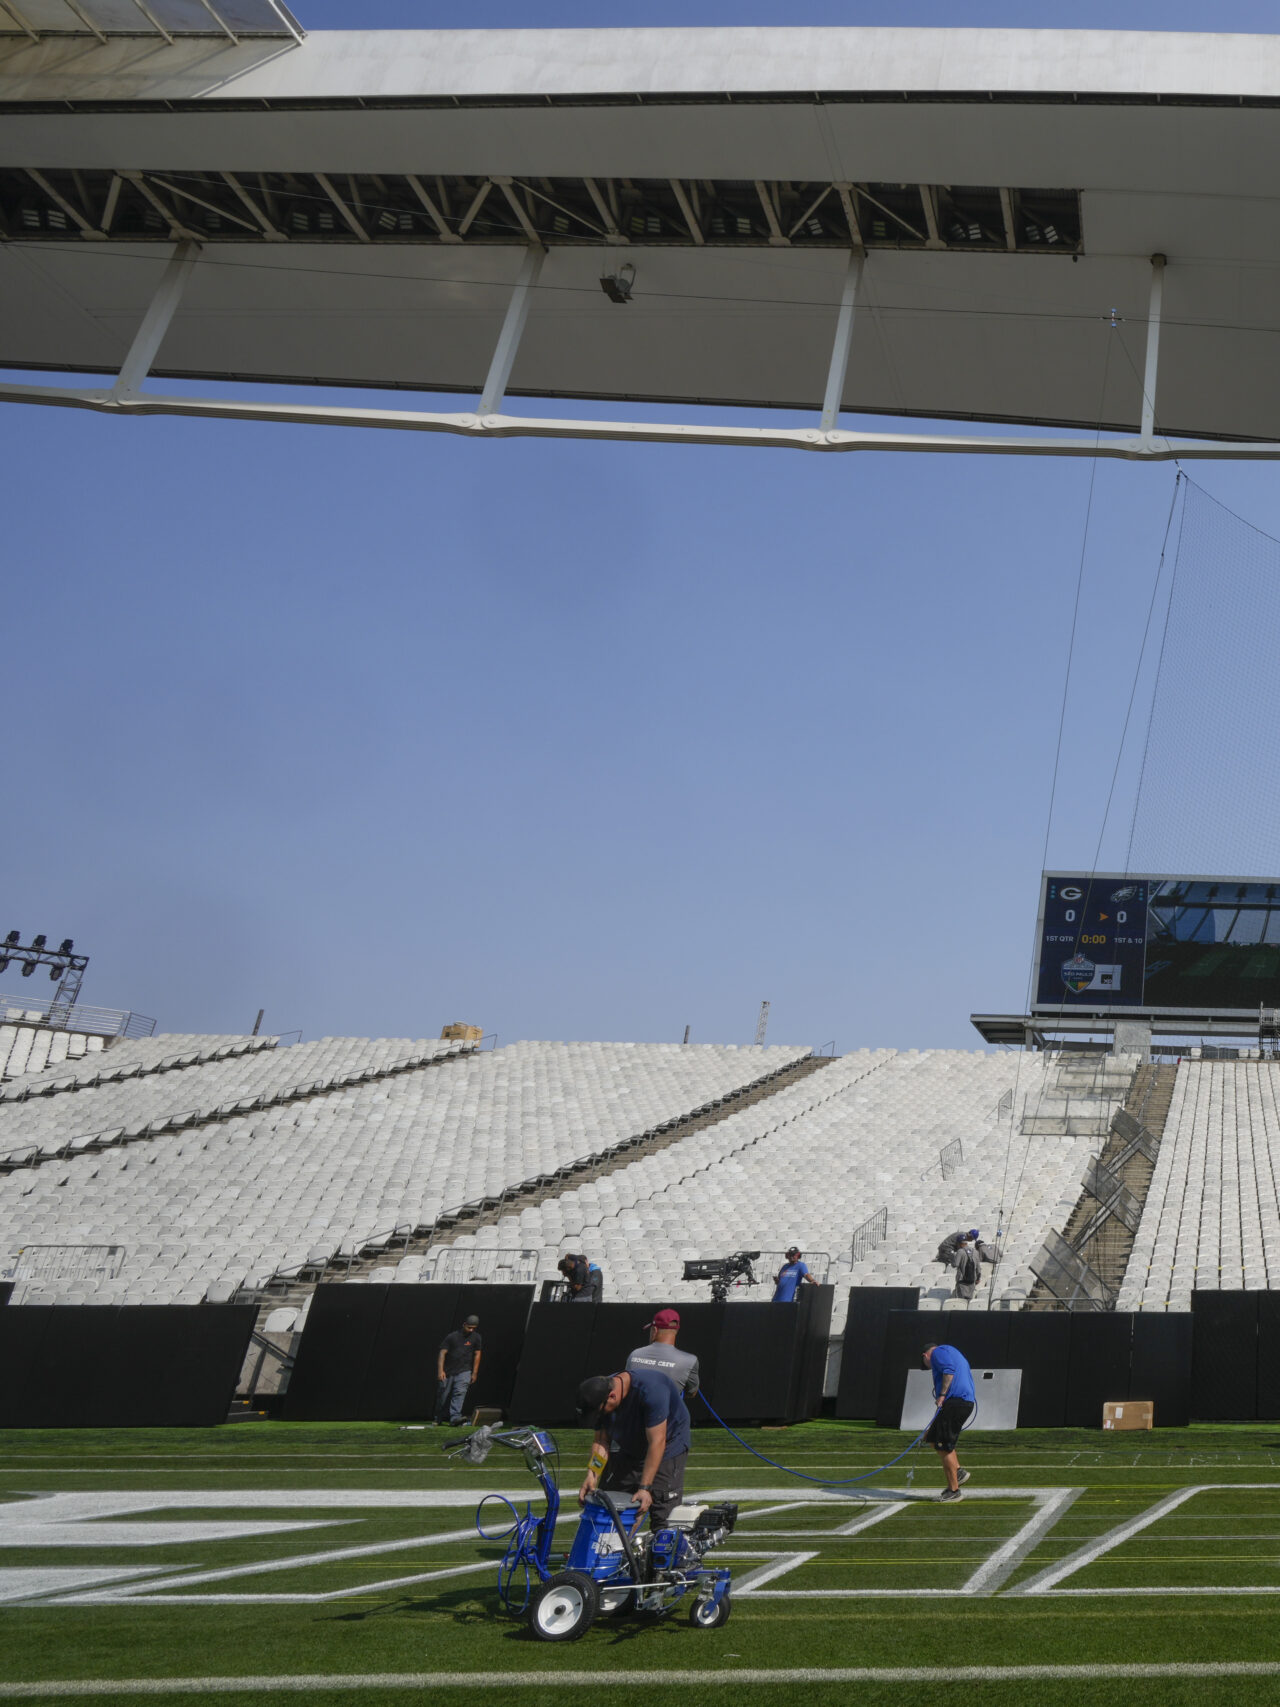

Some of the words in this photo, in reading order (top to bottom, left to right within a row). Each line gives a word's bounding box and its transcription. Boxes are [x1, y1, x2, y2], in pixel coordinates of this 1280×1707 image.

[1065, 909, 1076, 922] 0
[1116, 910, 1127, 924] 0
[1081, 934, 1107, 944] 0:00
